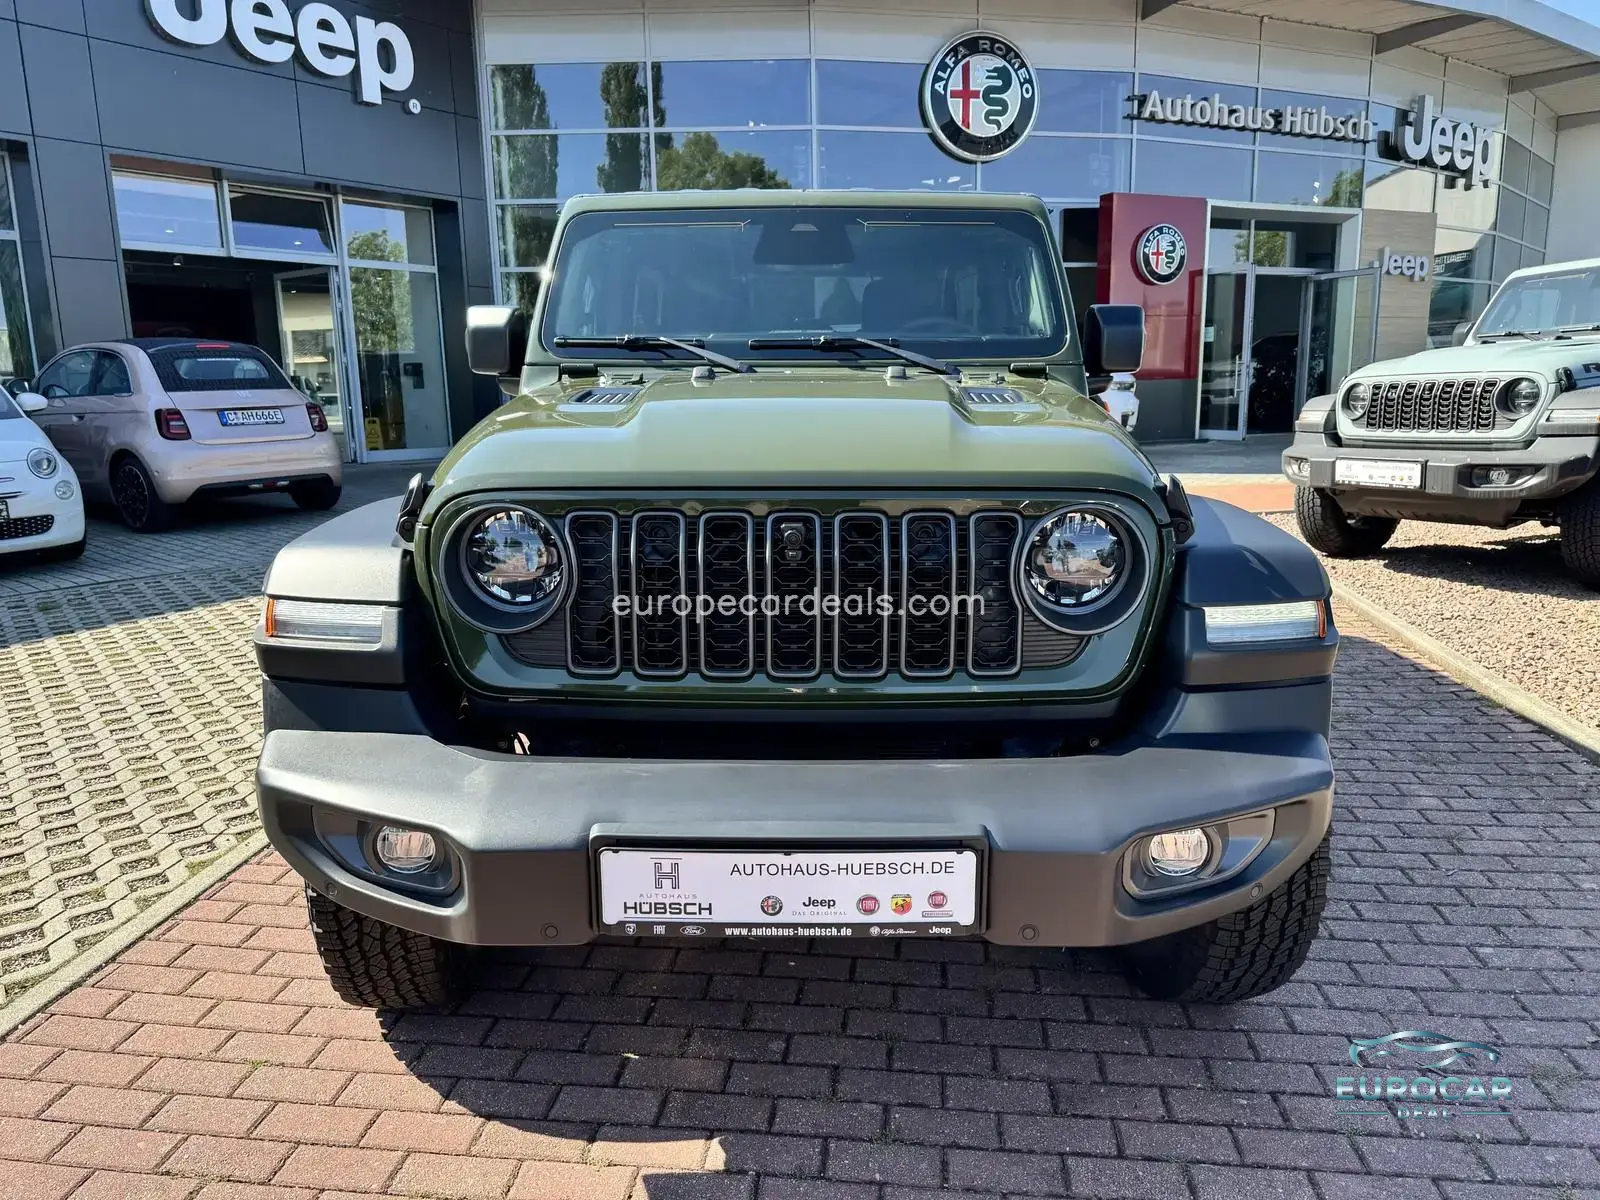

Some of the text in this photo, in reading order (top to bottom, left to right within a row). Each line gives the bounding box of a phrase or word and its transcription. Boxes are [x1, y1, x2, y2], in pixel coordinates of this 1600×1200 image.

[934, 39, 1033, 99] ALFA ROMEO
[1141, 90, 1373, 142] Autohaus Hübsch
[1403, 94, 1494, 187] Jeep
[1143, 227, 1185, 256] ALFA ROMEO
[1374, 246, 1429, 281] Jeep
[729, 861, 955, 877] AUTOHAUS-HUEBSCH.DE
[623, 902, 713, 916] HÜBSCH
[802, 896, 836, 909] Jeep
[862, 901, 876, 910] FIAT
[653, 925, 666, 935] FIAT
[724, 927, 852, 936] www.autohaus-huebsch.de
[928, 926, 952, 935] Jeep
